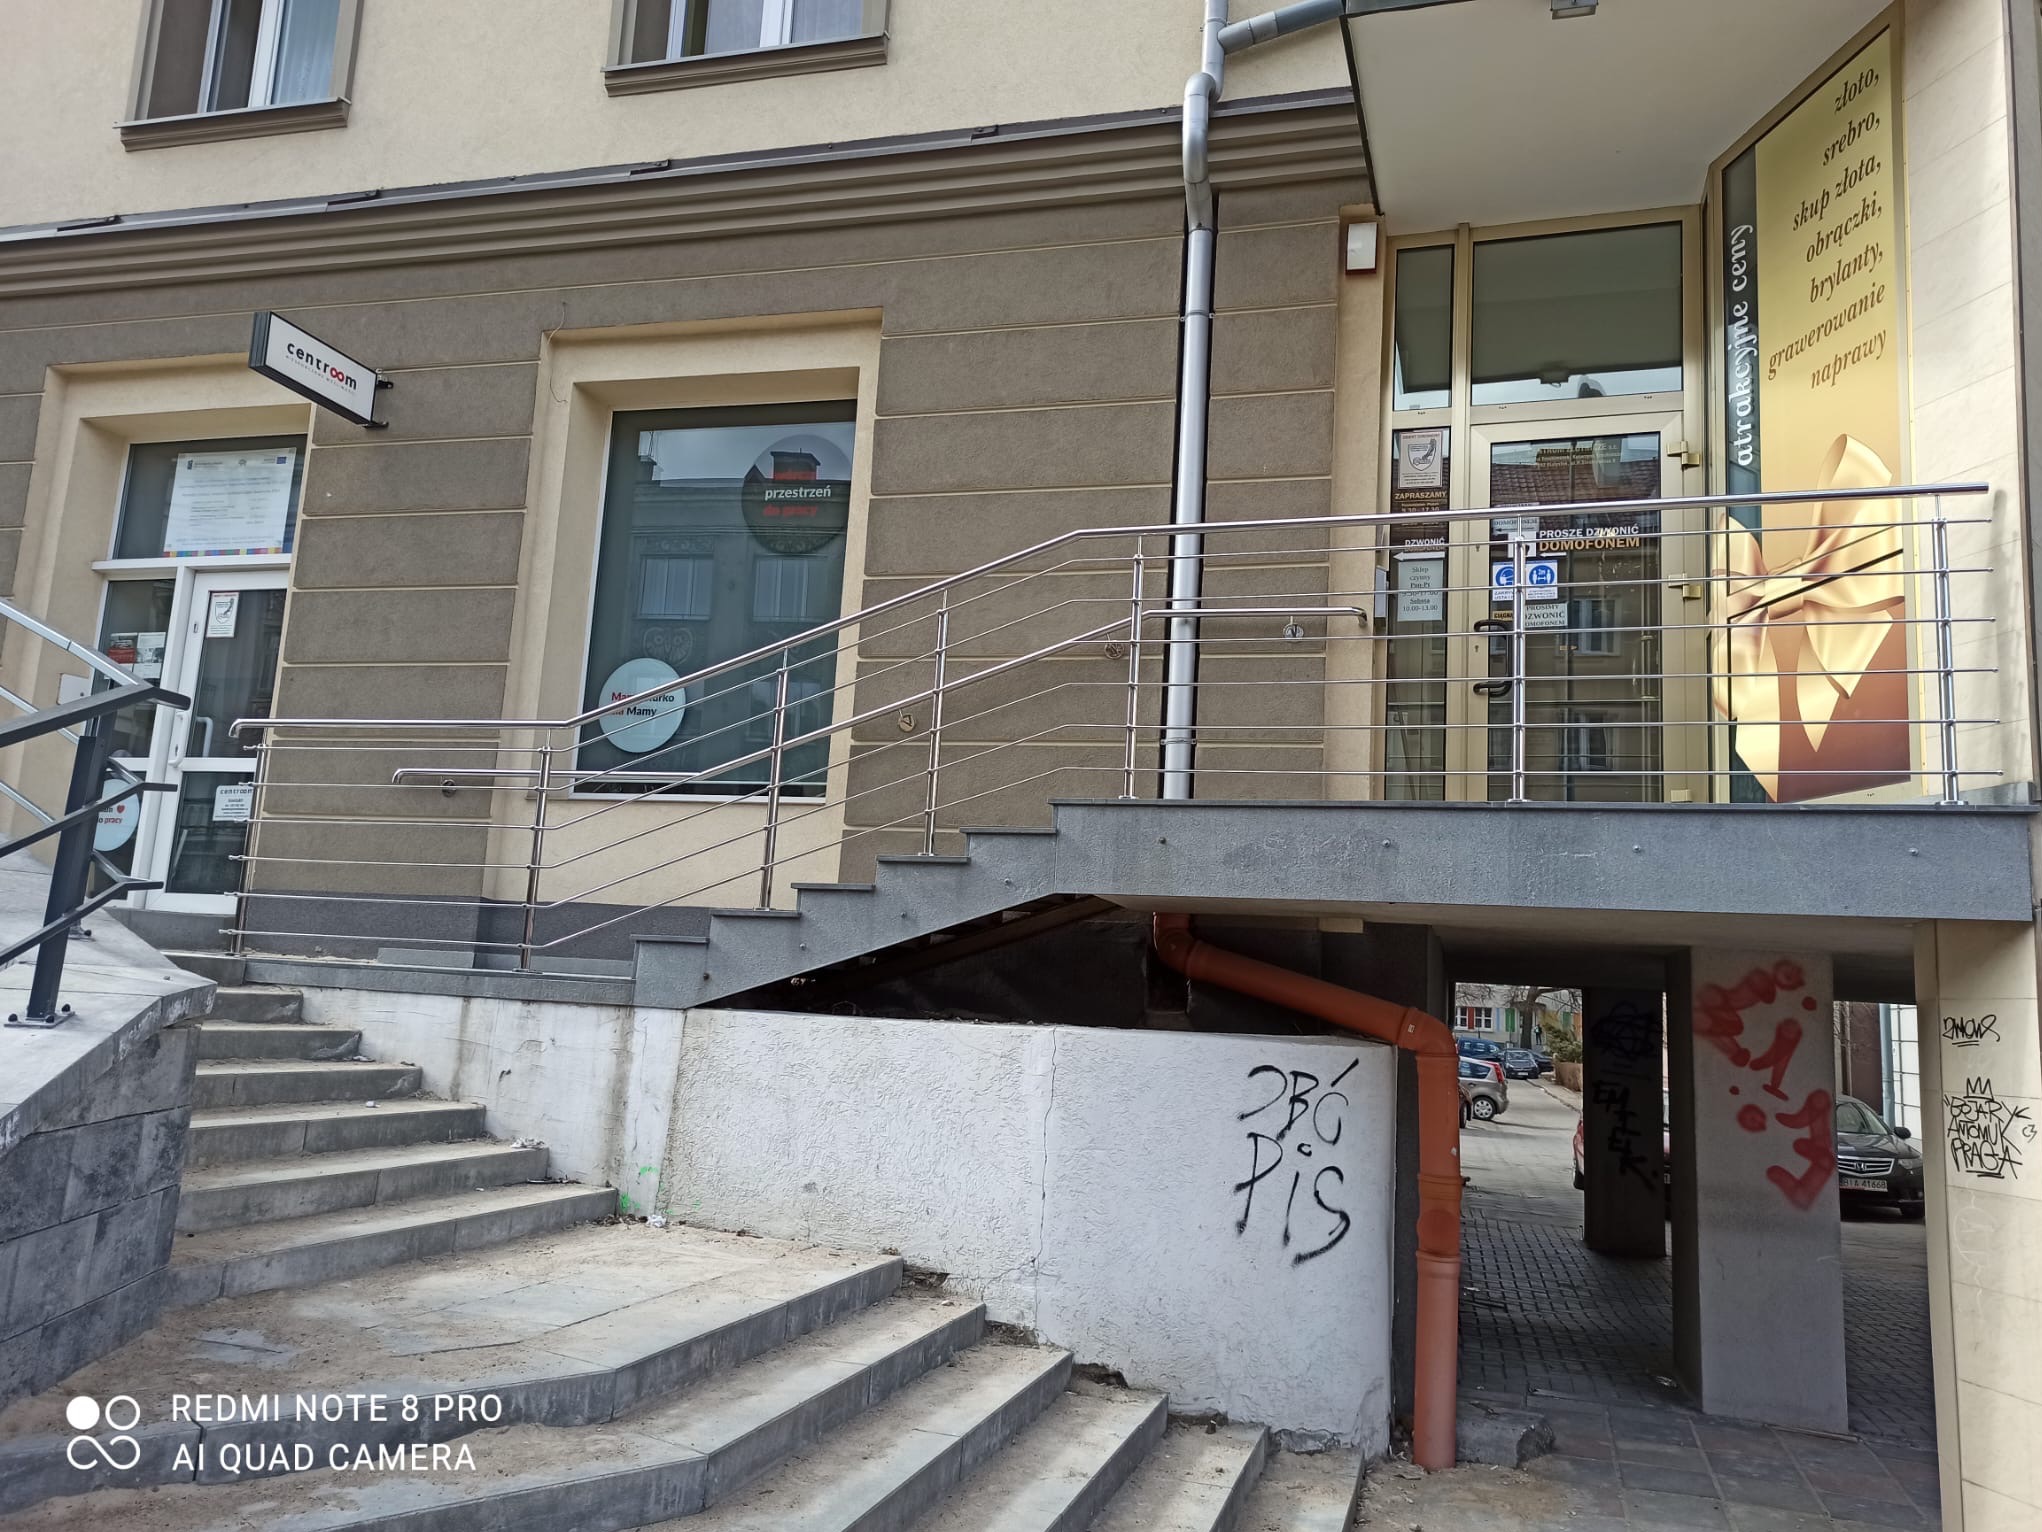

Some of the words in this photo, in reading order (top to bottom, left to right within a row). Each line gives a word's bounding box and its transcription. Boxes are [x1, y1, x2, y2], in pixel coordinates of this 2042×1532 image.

[1834, 67, 1880, 113] złoto,
[1822, 111, 1881, 167] srebro,
[1792, 188, 1831, 232] skup
[1834, 154, 1882, 199] złota,
[1806, 190, 1883, 263] obrączki,
[1730, 223, 1754, 293] ceny
[1809, 241, 1884, 304] brylanty,
[1767, 282, 1886, 381] grawerowanie
[286, 342, 358, 391] centroom
[1727, 300, 1758, 467] atrakcyjne
[1811, 329, 1887, 390] naprawy
[764, 484, 831, 501] przestrzeń
[1394, 490, 1448, 500] ZAPRASZAMY
[1404, 537, 1446, 545] DZWONIĆ
[1539, 537, 1641, 551] DOMOFONEM
[1586, 523, 1640, 537] DZWONIĆ
[626, 706, 657, 718] Mamy
[104, 816, 123, 825] pracy
